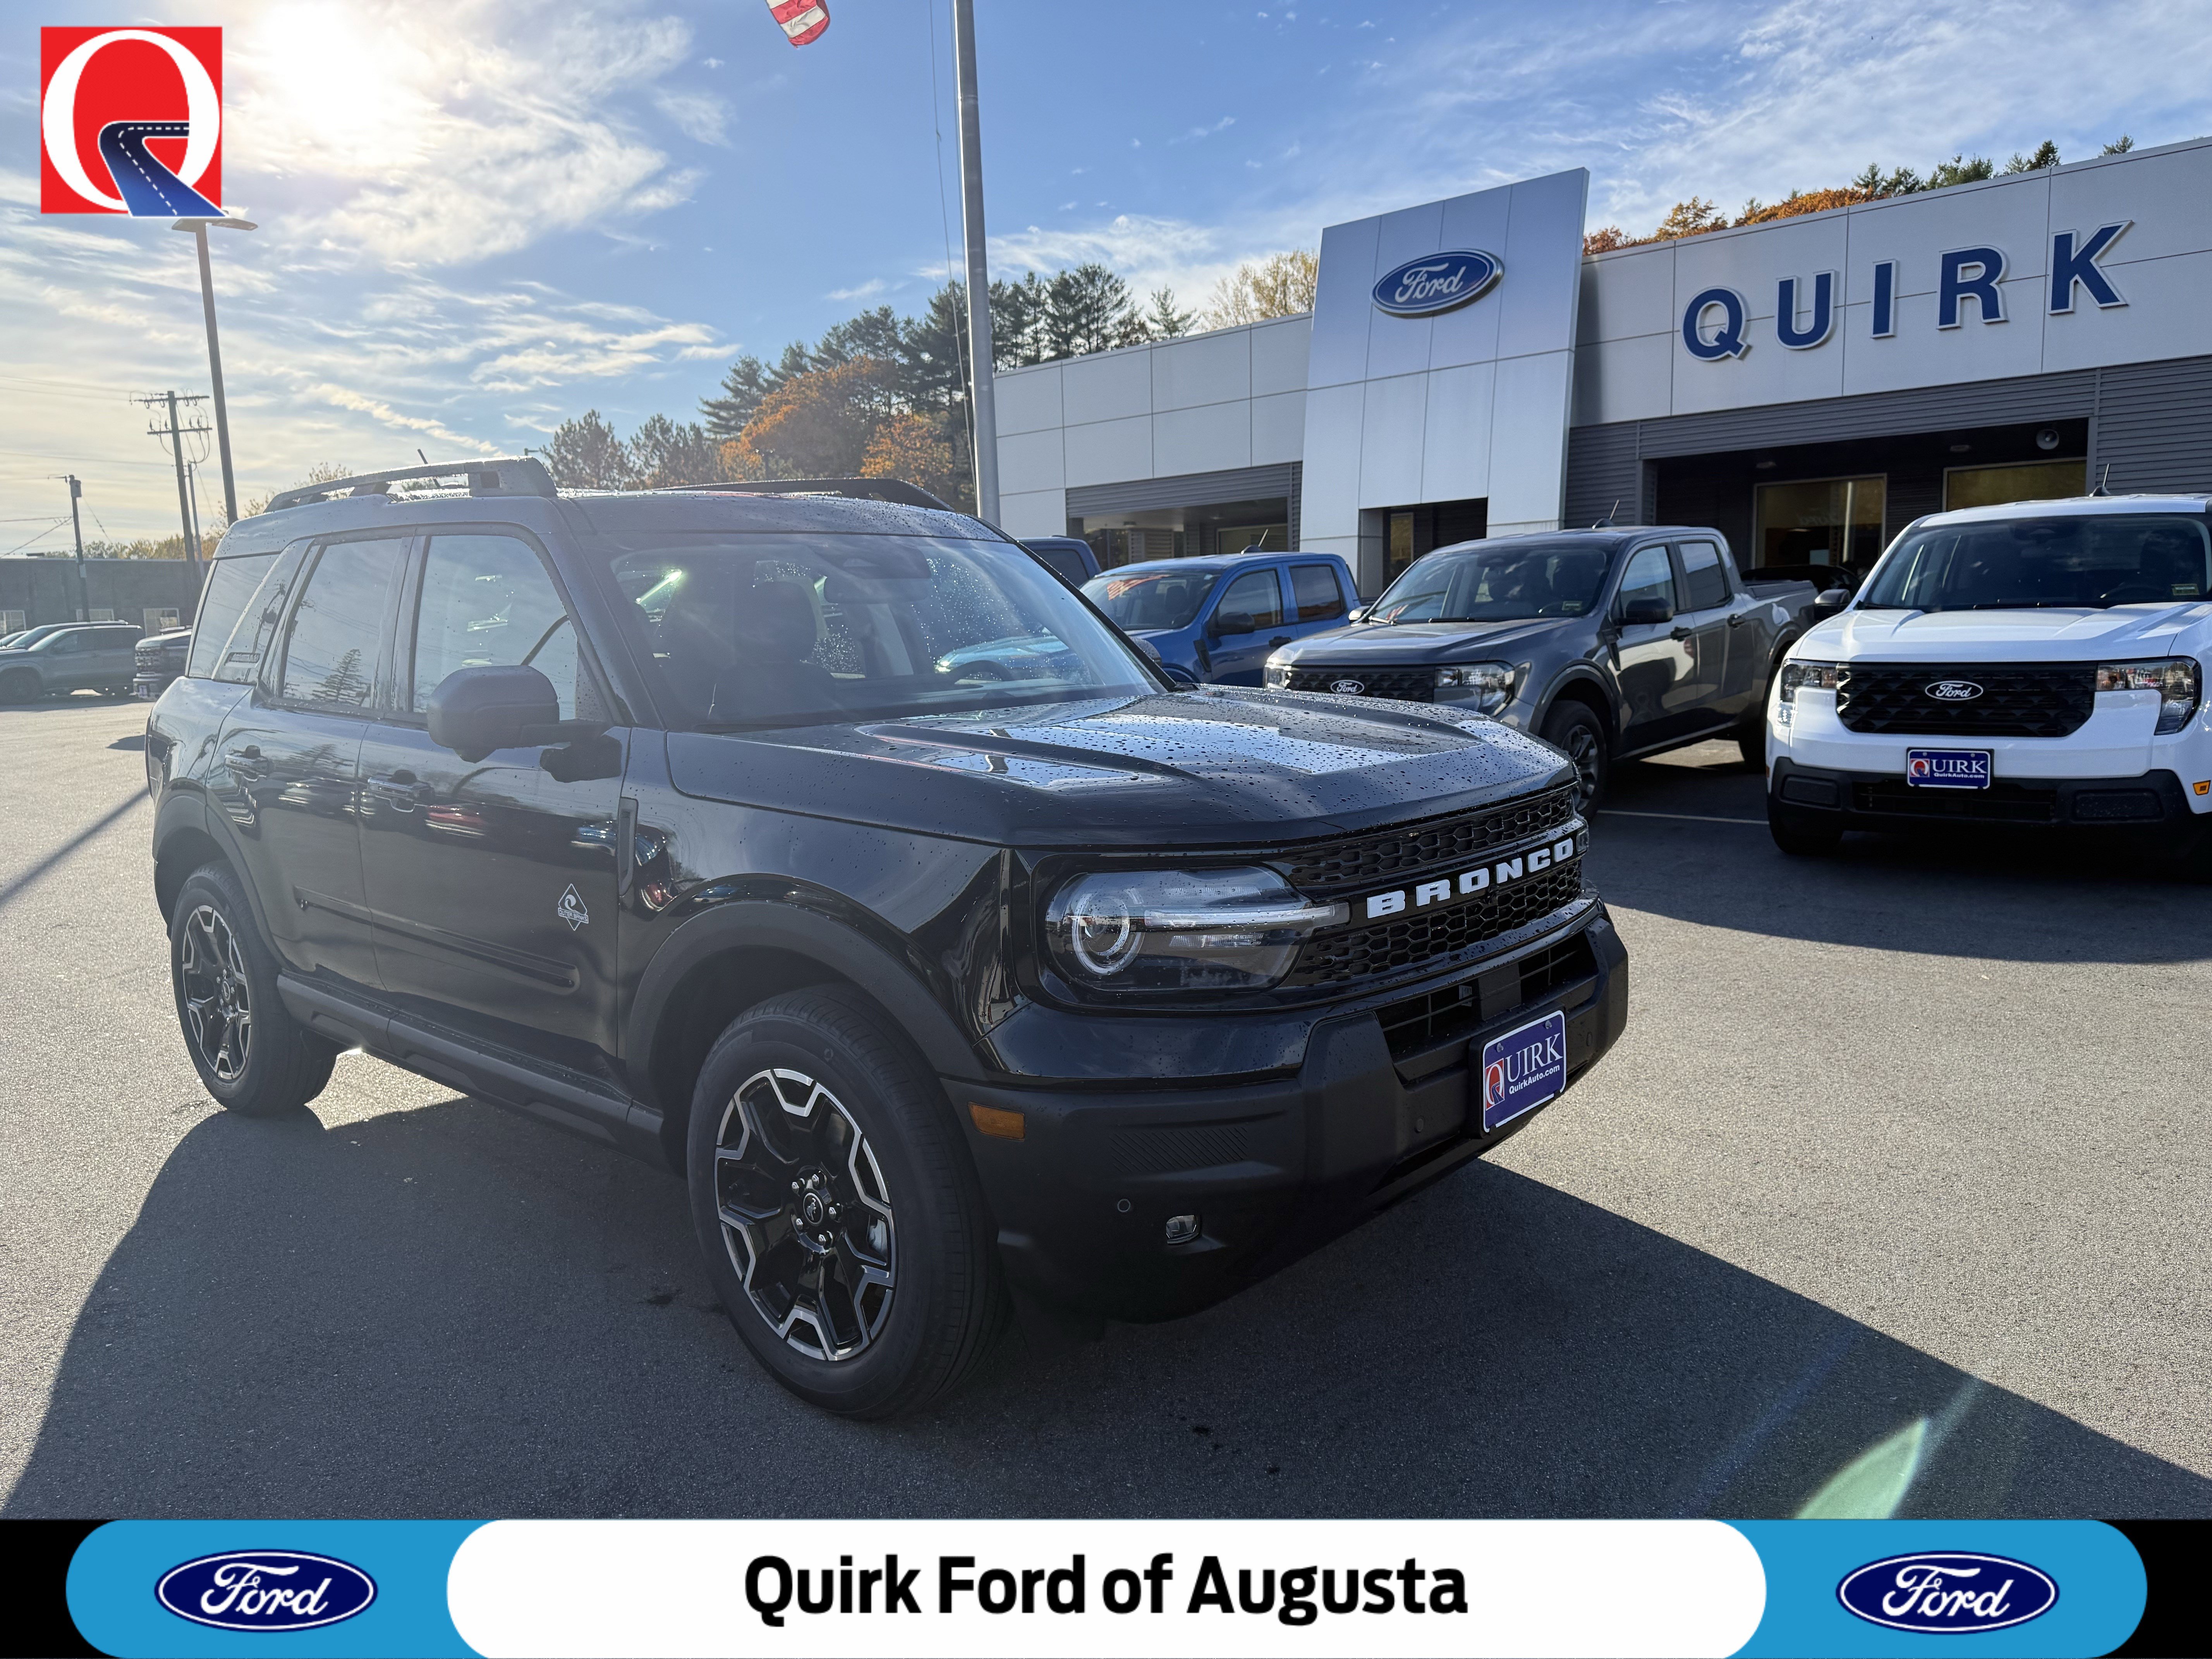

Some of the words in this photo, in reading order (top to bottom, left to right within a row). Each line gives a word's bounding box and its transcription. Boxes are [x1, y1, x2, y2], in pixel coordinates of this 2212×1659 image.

[1395, 263, 1467, 303] Ford
[1681, 222, 2131, 360] QUIRK
[1336, 682, 1358, 692] Ford
[1936, 683, 1972, 697] Ford
[1911, 759, 1987, 777] QUIRK
[1367, 837, 1574, 919] BRONCO
[559, 910, 573, 918] OUTER
[1486, 1032, 1563, 1105] QUIRK
[1509, 1065, 1560, 1095] QuirkAuto.com
